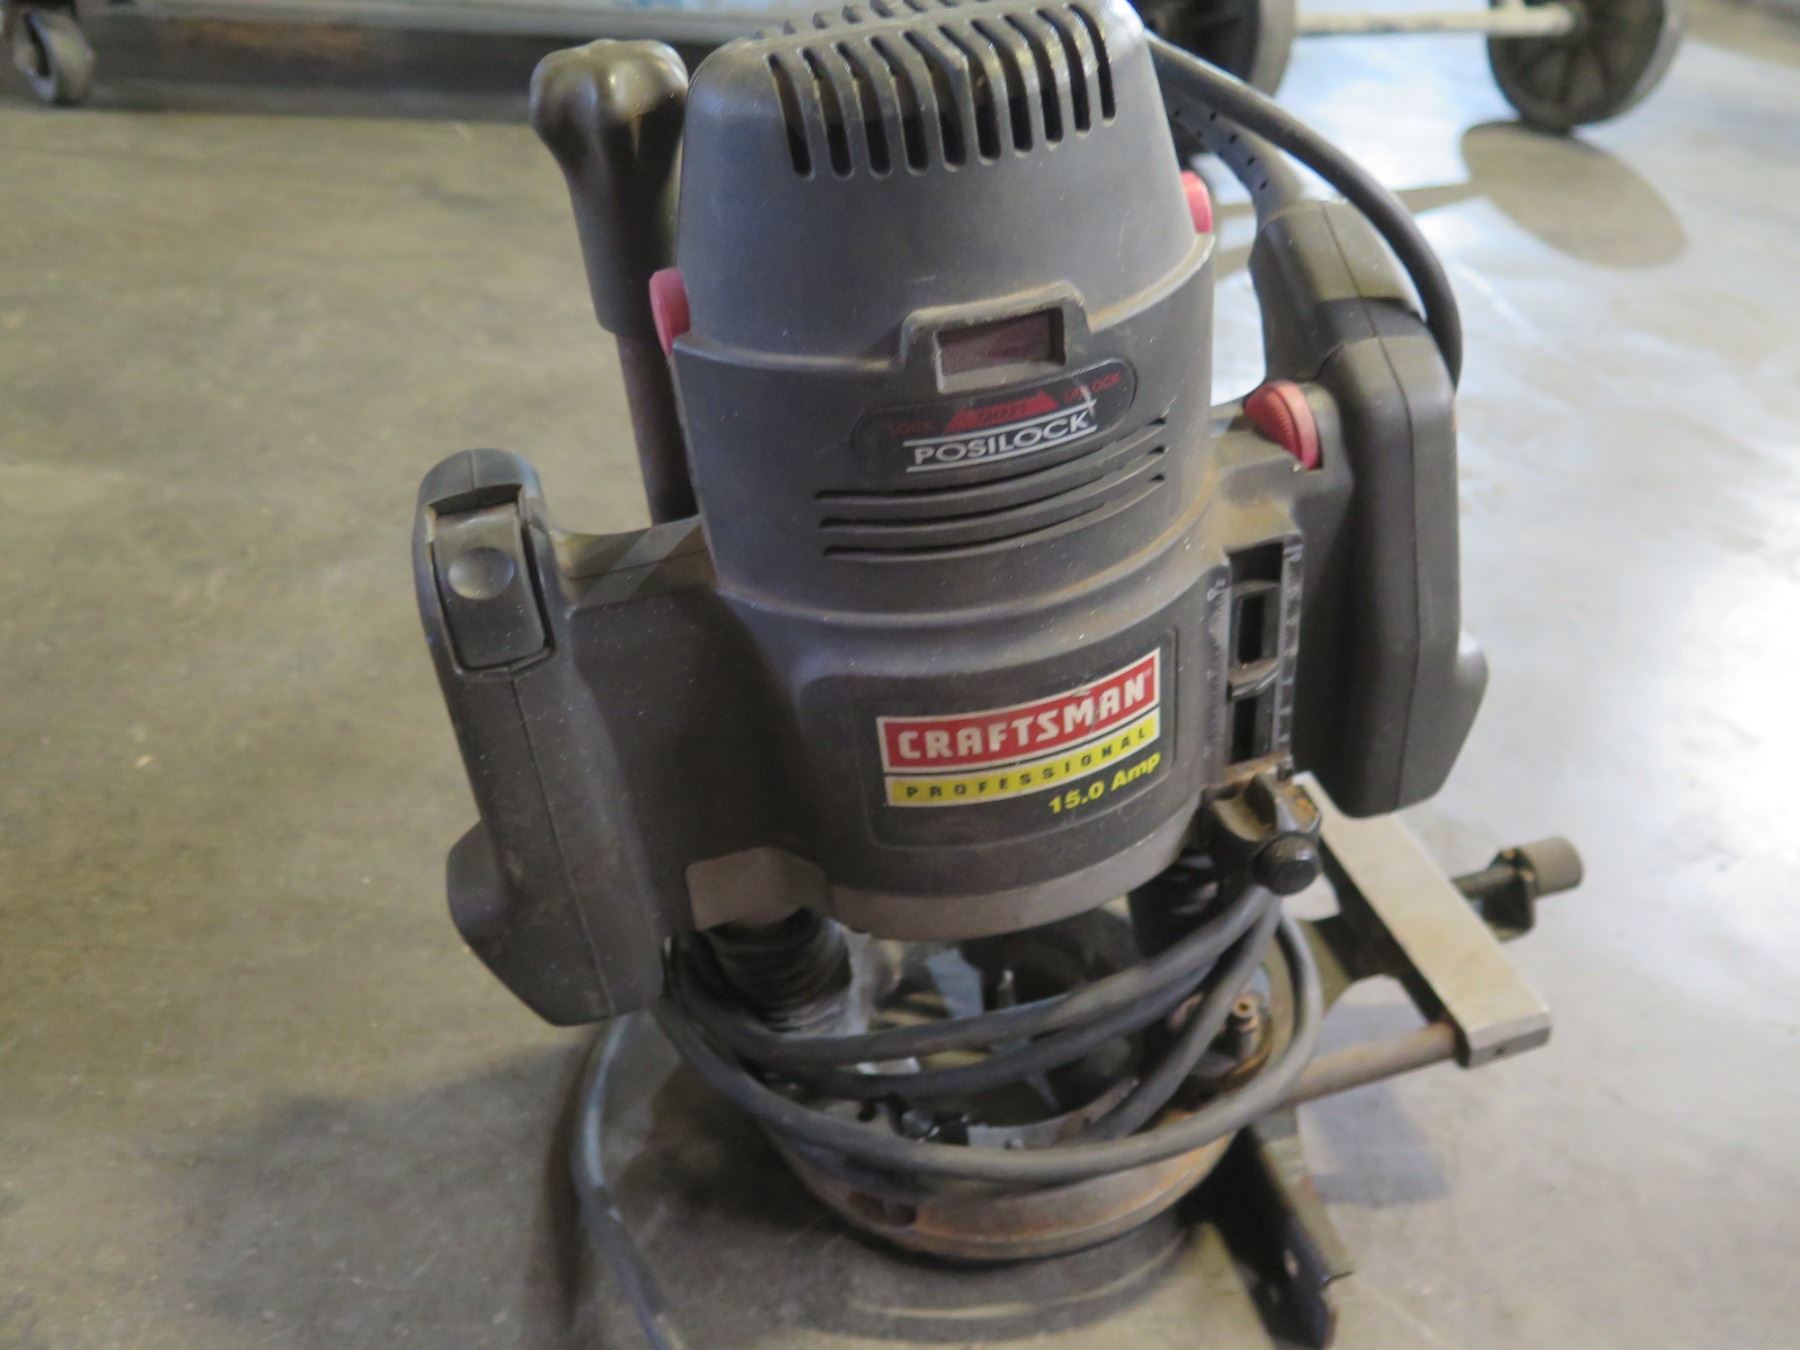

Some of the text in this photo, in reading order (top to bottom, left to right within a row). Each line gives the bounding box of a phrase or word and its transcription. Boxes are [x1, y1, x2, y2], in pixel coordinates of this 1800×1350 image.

[913, 412, 1090, 464] POSILOCK
[898, 674, 1146, 760] CRAFTSMAN
[906, 727, 1147, 799] PROFESSIONAL
[1048, 752, 1161, 814] 15.0 Amp
